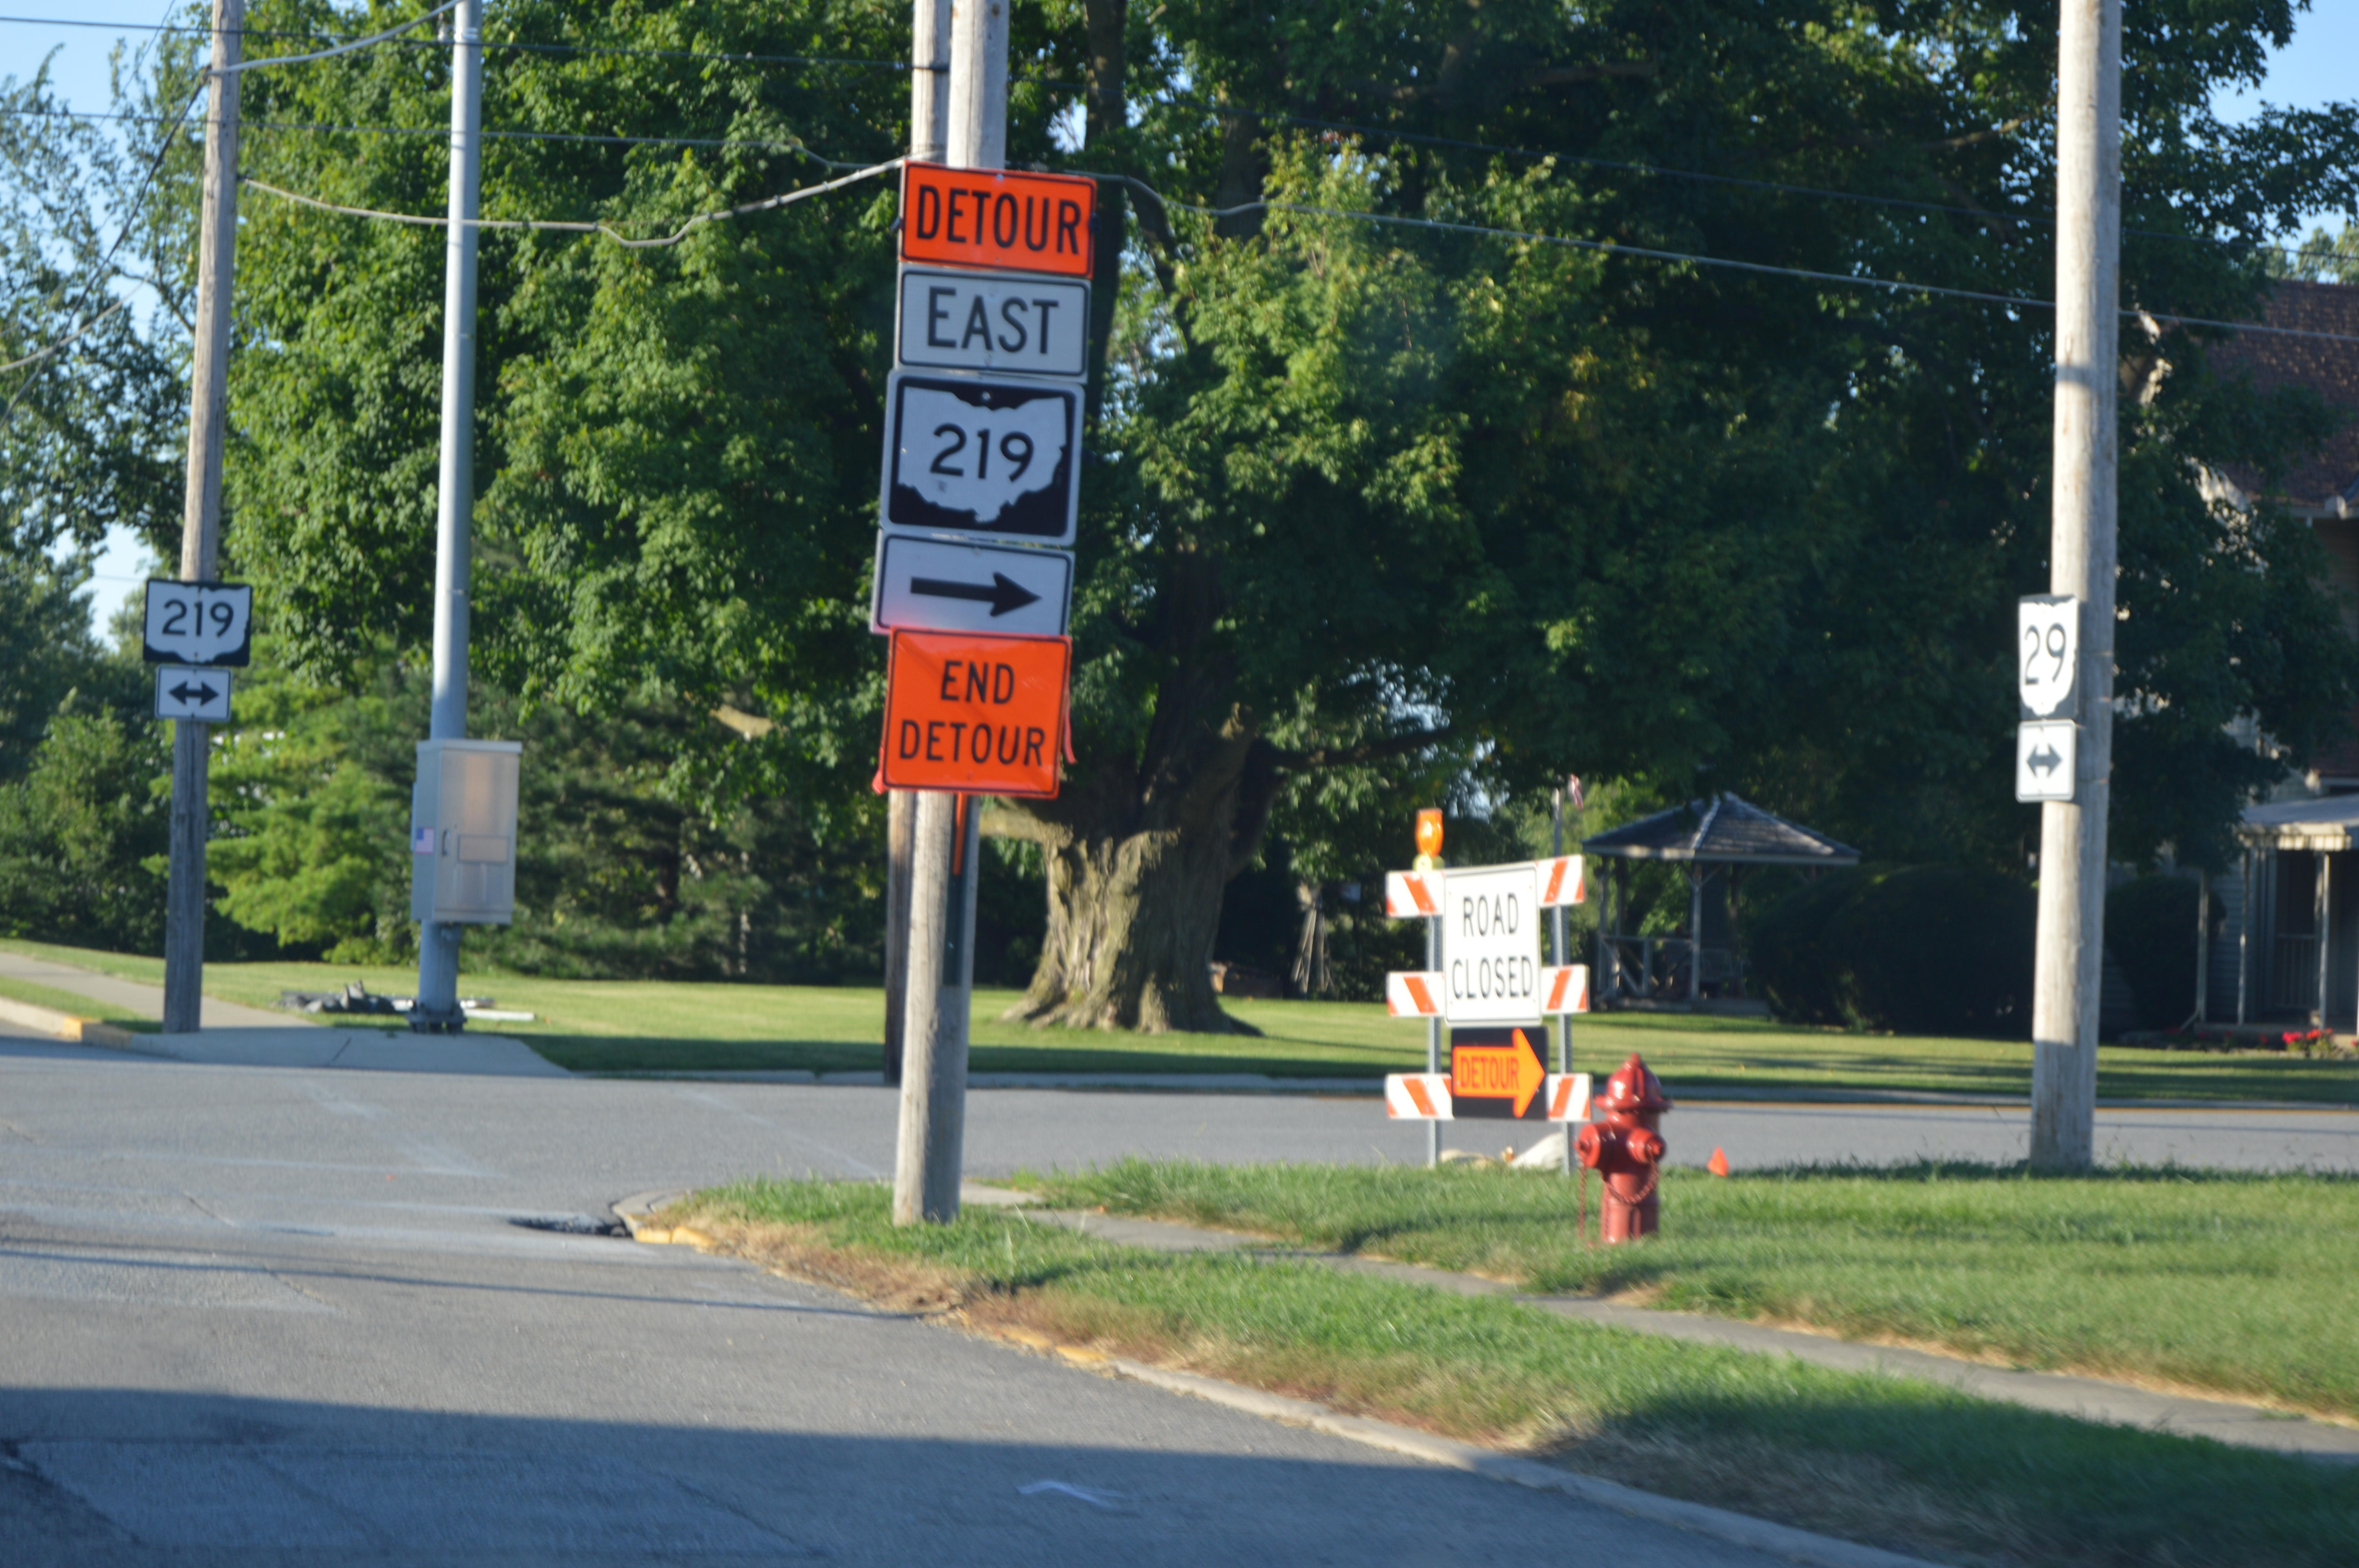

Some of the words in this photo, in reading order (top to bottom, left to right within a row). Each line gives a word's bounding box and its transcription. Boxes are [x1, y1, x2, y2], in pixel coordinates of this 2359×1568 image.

[917, 184, 1081, 255] DETOUR
[928, 286, 1059, 354] EAST
[930, 423, 1034, 483] 219
[162, 599, 234, 637] 219
[2025, 622, 2066, 686] 29
[941, 660, 1014, 704] END
[900, 719, 1045, 767] DETOUR
[1463, 892, 1519, 937] ROAD
[1452, 955, 1533, 999] CLOSED
[1460, 1055, 1519, 1089] DETOUR
